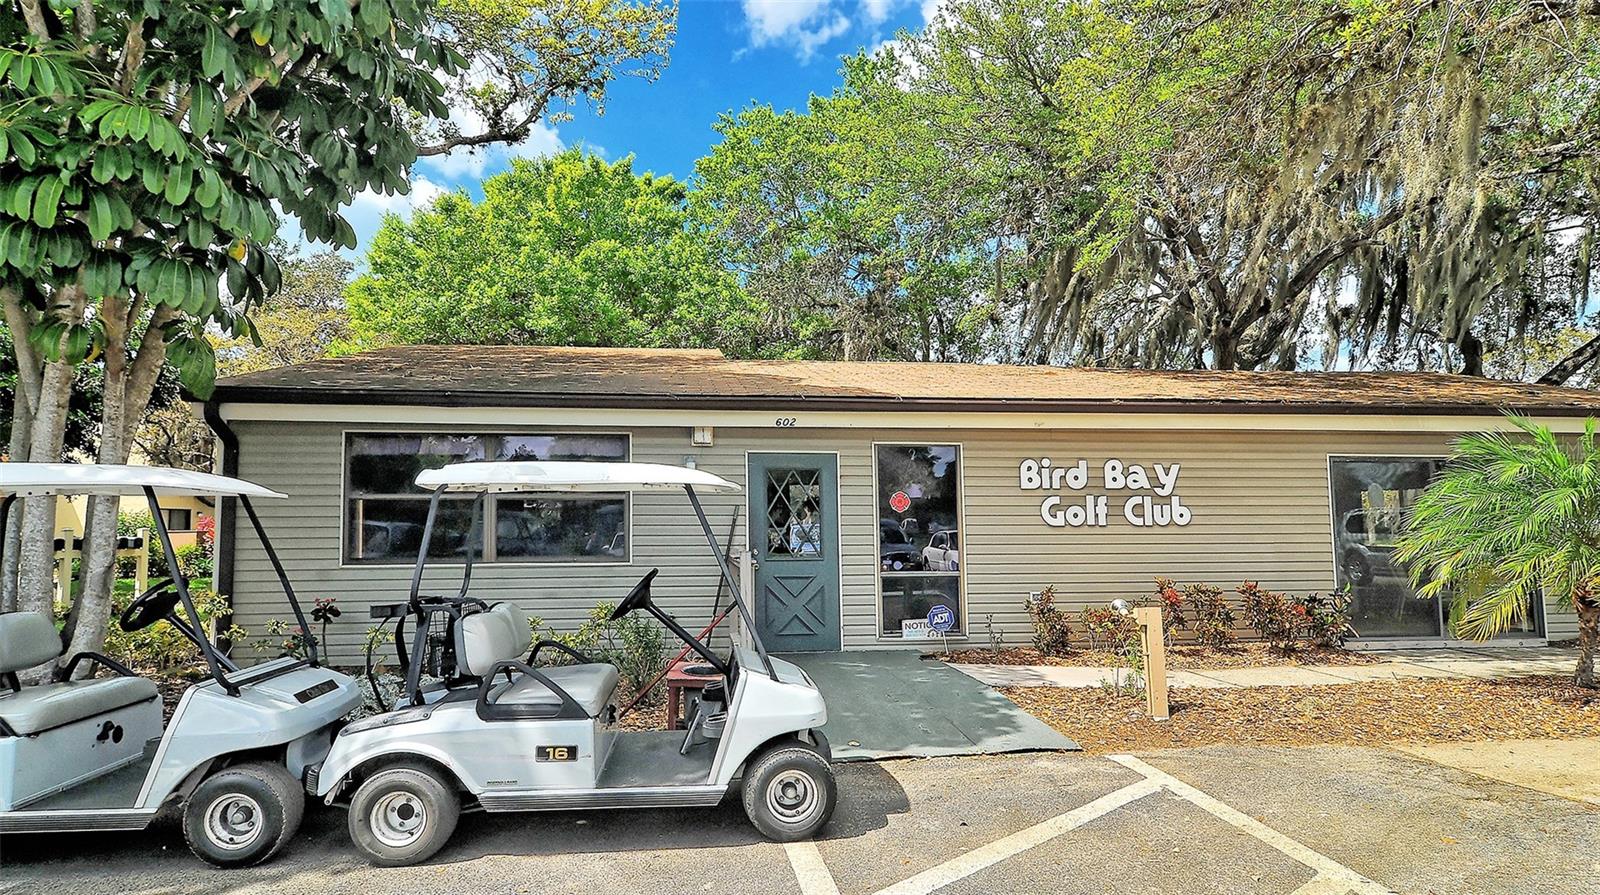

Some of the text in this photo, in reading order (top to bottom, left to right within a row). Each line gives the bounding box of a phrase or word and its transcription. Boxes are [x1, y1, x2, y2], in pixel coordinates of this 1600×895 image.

[775, 417, 797, 427] 602
[1019, 458, 1181, 497] Bird Bay
[1040, 495, 1192, 527] Golf Club
[933, 612, 949, 624] ADT
[904, 621, 932, 630] NOTIC
[545, 747, 569, 760] 16
